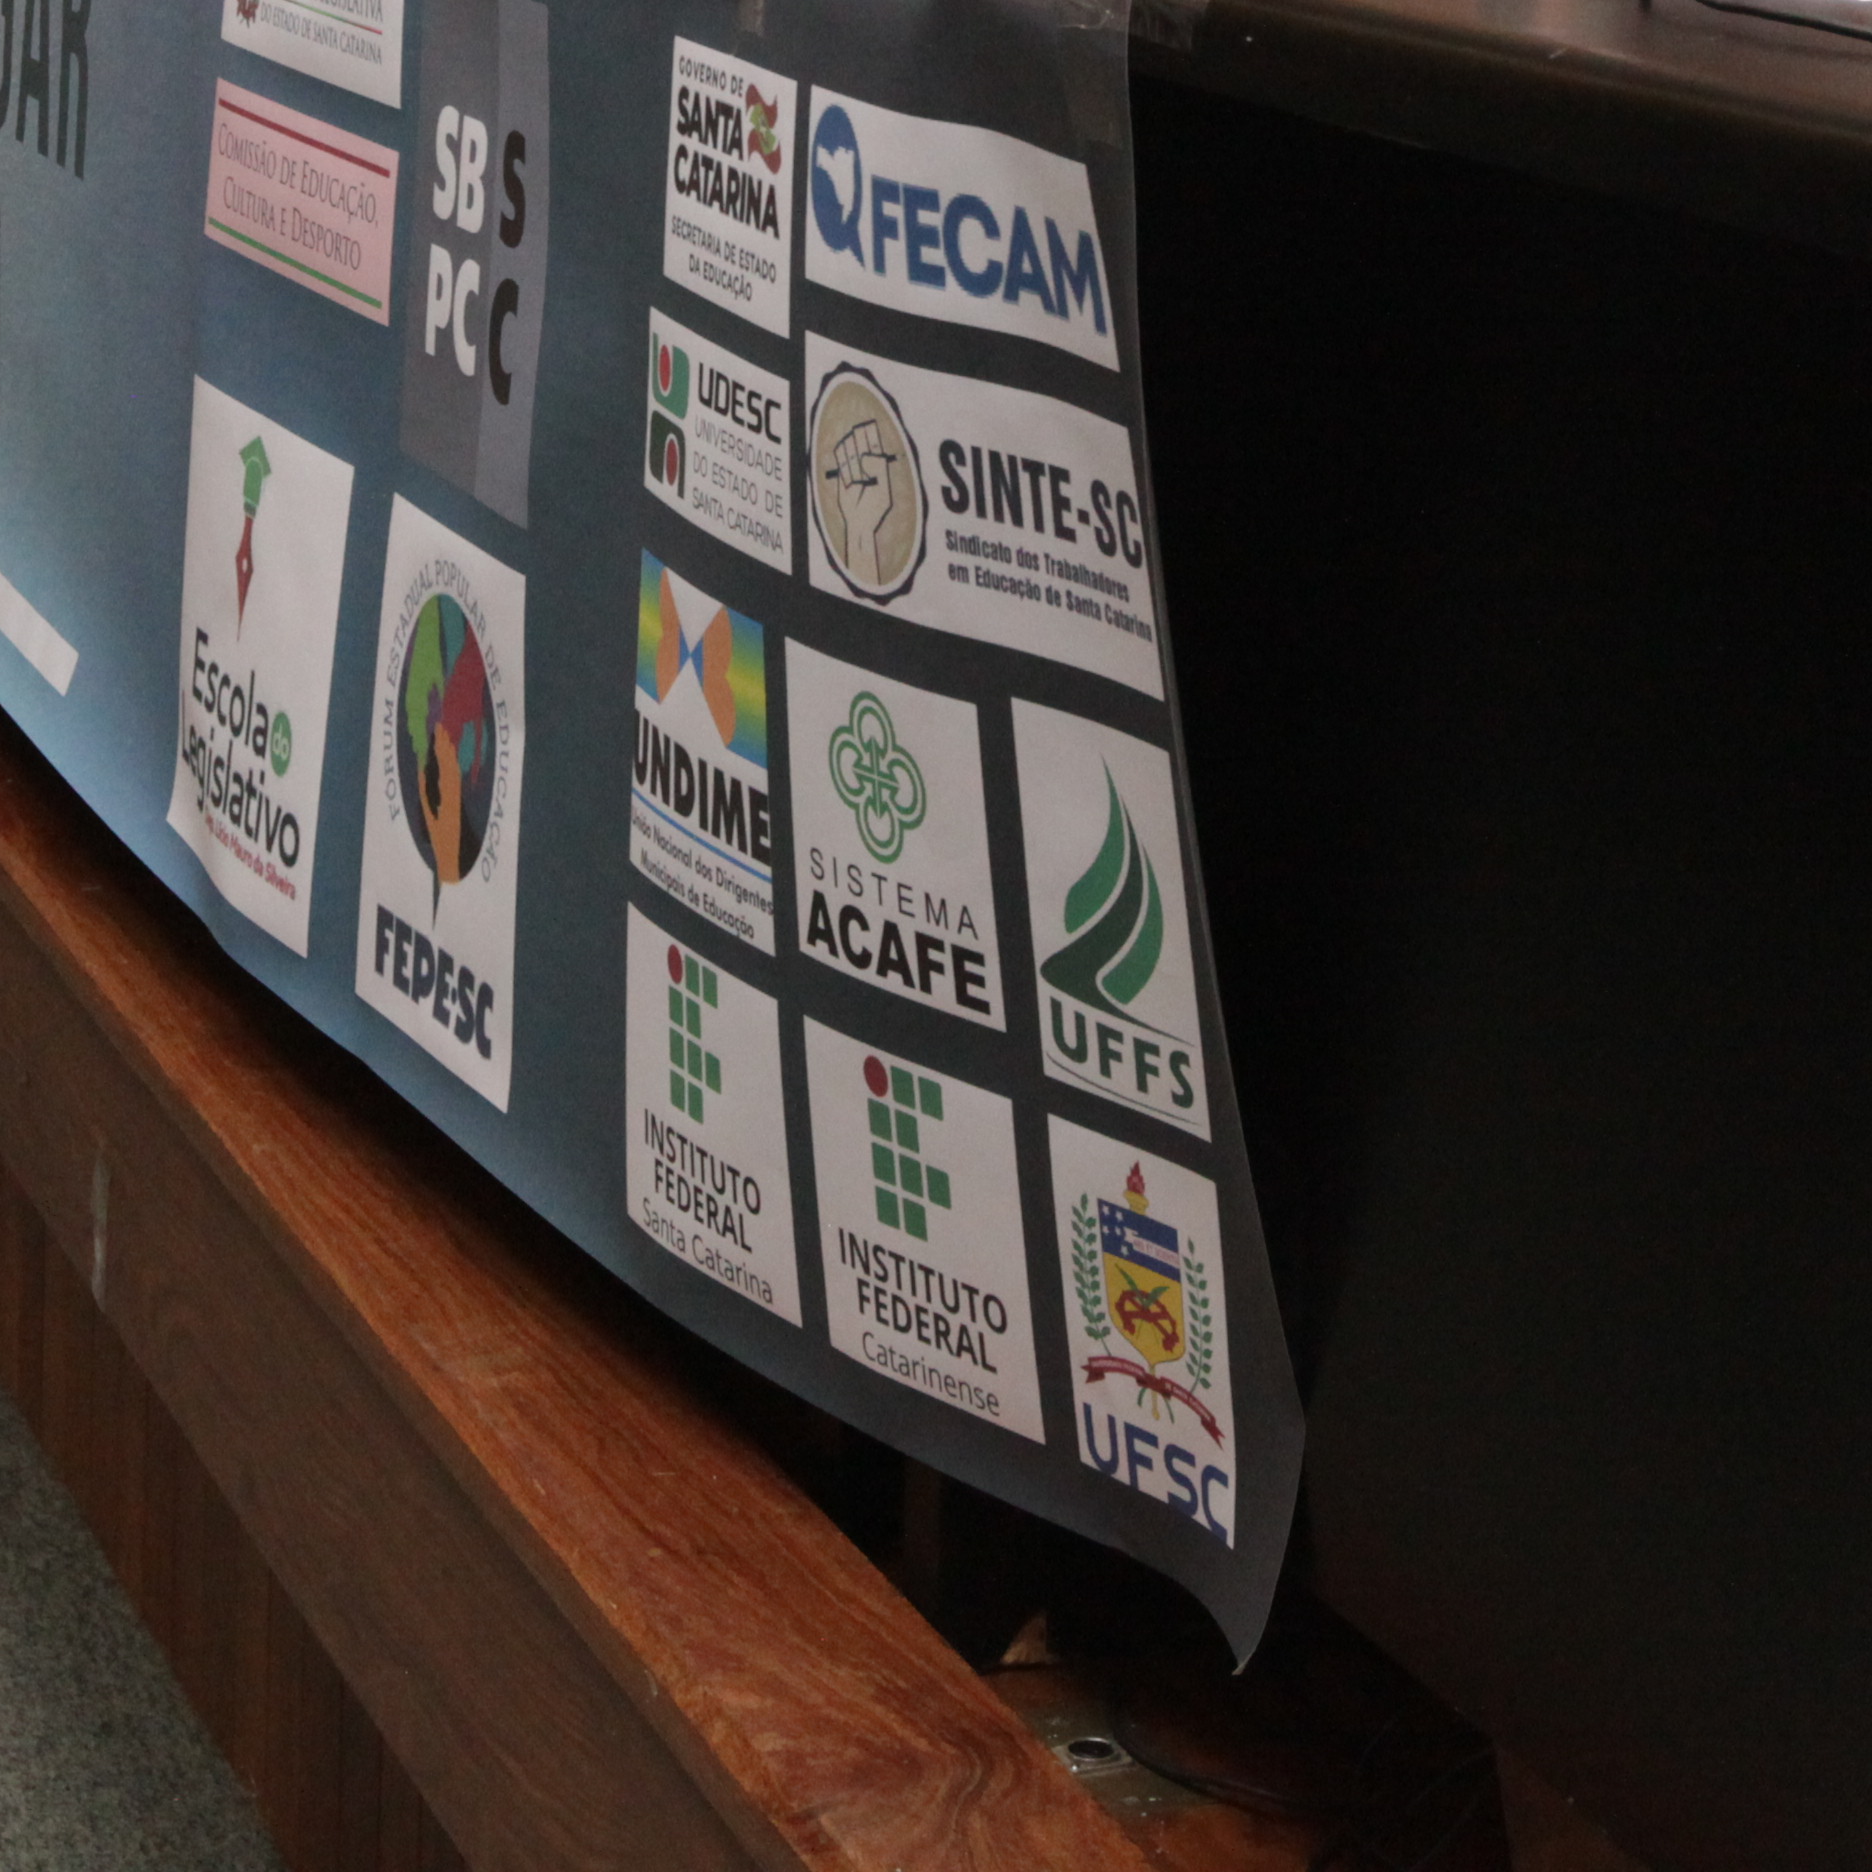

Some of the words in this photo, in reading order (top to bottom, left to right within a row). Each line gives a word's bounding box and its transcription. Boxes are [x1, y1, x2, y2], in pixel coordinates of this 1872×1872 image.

[259, 0, 272, 25] DO
[272, 6, 300, 36] ESTADO
[301, 16, 312, 40] DE
[312, 21, 338, 50] SANTA
[339, 30, 383, 66] CATARINA
[678, 54, 727, 92] GOVERNO
[730, 74, 744, 98] DE
[677, 84, 745, 162] SANTA
[673, 144, 781, 240] CATARINA
[671, 214, 722, 258] SECRETARIA
[724, 240, 737, 265] DE
[739, 247, 777, 284] ESTADO
[689, 253, 701, 277] DA
[871, 174, 1108, 337] FECAM
[694, 414, 783, 482] UNIVERSIDADE
[697, 361, 782, 445] UDESC
[691, 486, 725, 524] SANTA
[726, 506, 784, 554] CATARINA
[692, 450, 708, 478] DO
[711, 461, 758, 506] ESTADO
[764, 489, 784, 519] DE
[938, 438, 1143, 569] SINTE-SC
[944, 528, 1012, 565] Sindicato
[1015, 546, 1040, 571] dos
[1043, 552, 1131, 603] Trabalhadores
[947, 563, 970, 584] em
[974, 565, 1042, 602] Educação
[1045, 584, 1063, 608] de
[1066, 588, 1102, 622] Santa
[1104, 603, 1153, 643] Catarina
[386, 563, 433, 688] ESTADUAL
[433, 558, 487, 637] POPULAR
[191, 626, 270, 760] Escola
[271, 723, 289, 762] do
[181, 688, 301, 868] Legislativo
[634, 708, 771, 868] UNDIME
[640, 847, 686, 898] Municipais
[687, 880, 700, 908] de
[653, 824, 693, 869] Nacional
[695, 854, 713, 882] dos
[715, 866, 774, 916] Dirigentes
[809, 846, 979, 941] SISTEMA
[806, 889, 991, 1016] ACAFE
[1049, 995, 1194, 1109] UFFS
[644, 1107, 762, 1216] INSTITUTO
[654, 1157, 753, 1254] FEDERAL
[643, 1196, 686, 1253] Santa
[691, 1233, 773, 1305] Catarina
[838, 1226, 1008, 1335] INSTITUTO
[856, 1276, 998, 1376] FEDERAL
[861, 1330, 1001, 1417] Catarinense
[1083, 1401, 1229, 1548] UFSC
